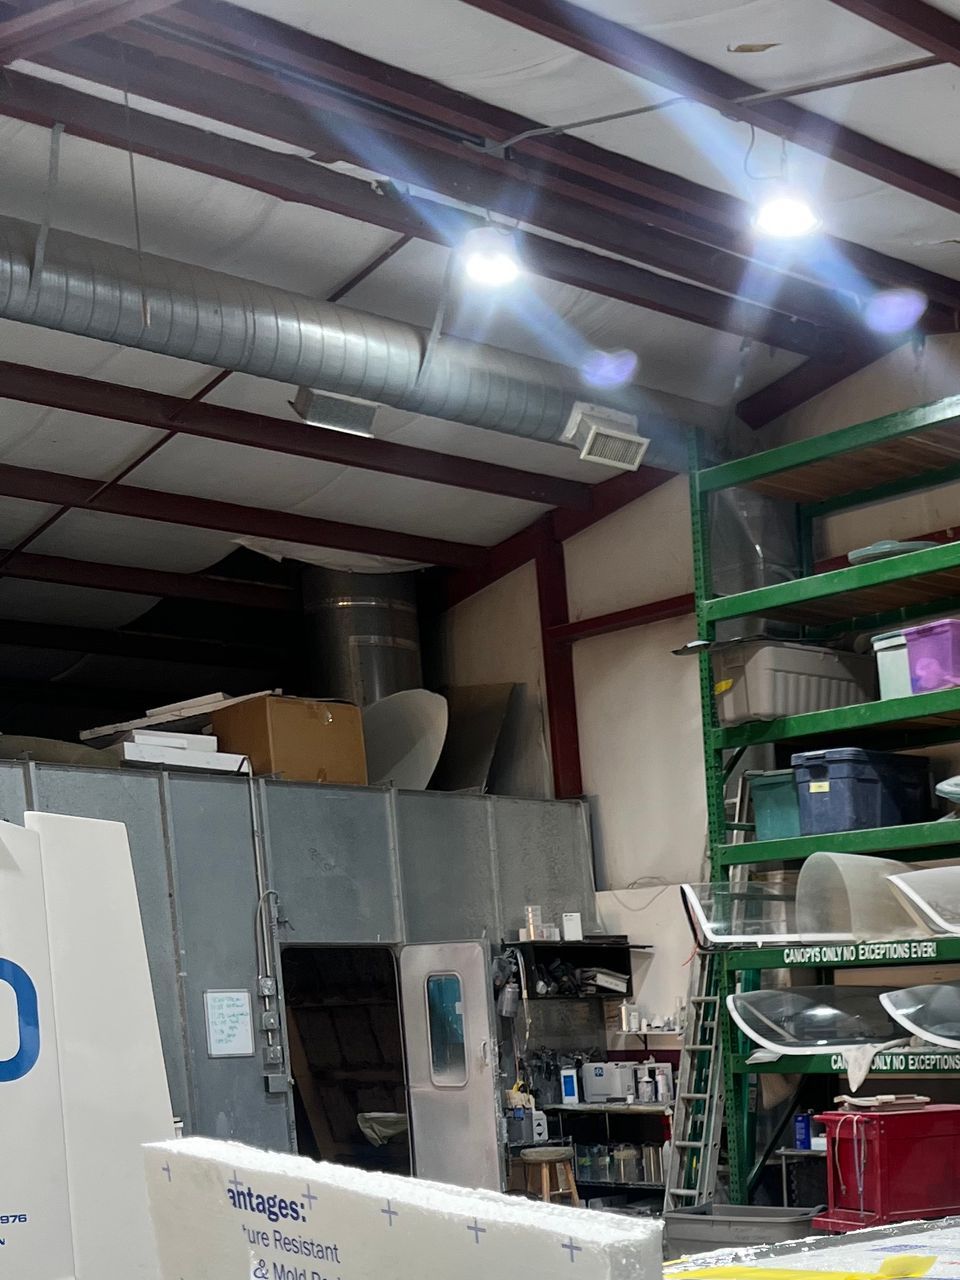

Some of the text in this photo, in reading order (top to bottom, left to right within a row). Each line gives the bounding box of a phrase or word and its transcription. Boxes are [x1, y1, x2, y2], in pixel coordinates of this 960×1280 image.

[784, 942, 937, 964] CANOPYS ONLY NO EXCEPTIONS EVER!
[871, 1055, 892, 1070] ONLY
[893, 1055, 905, 1070] NO
[242, 1225, 341, 1263] ure Resistant
